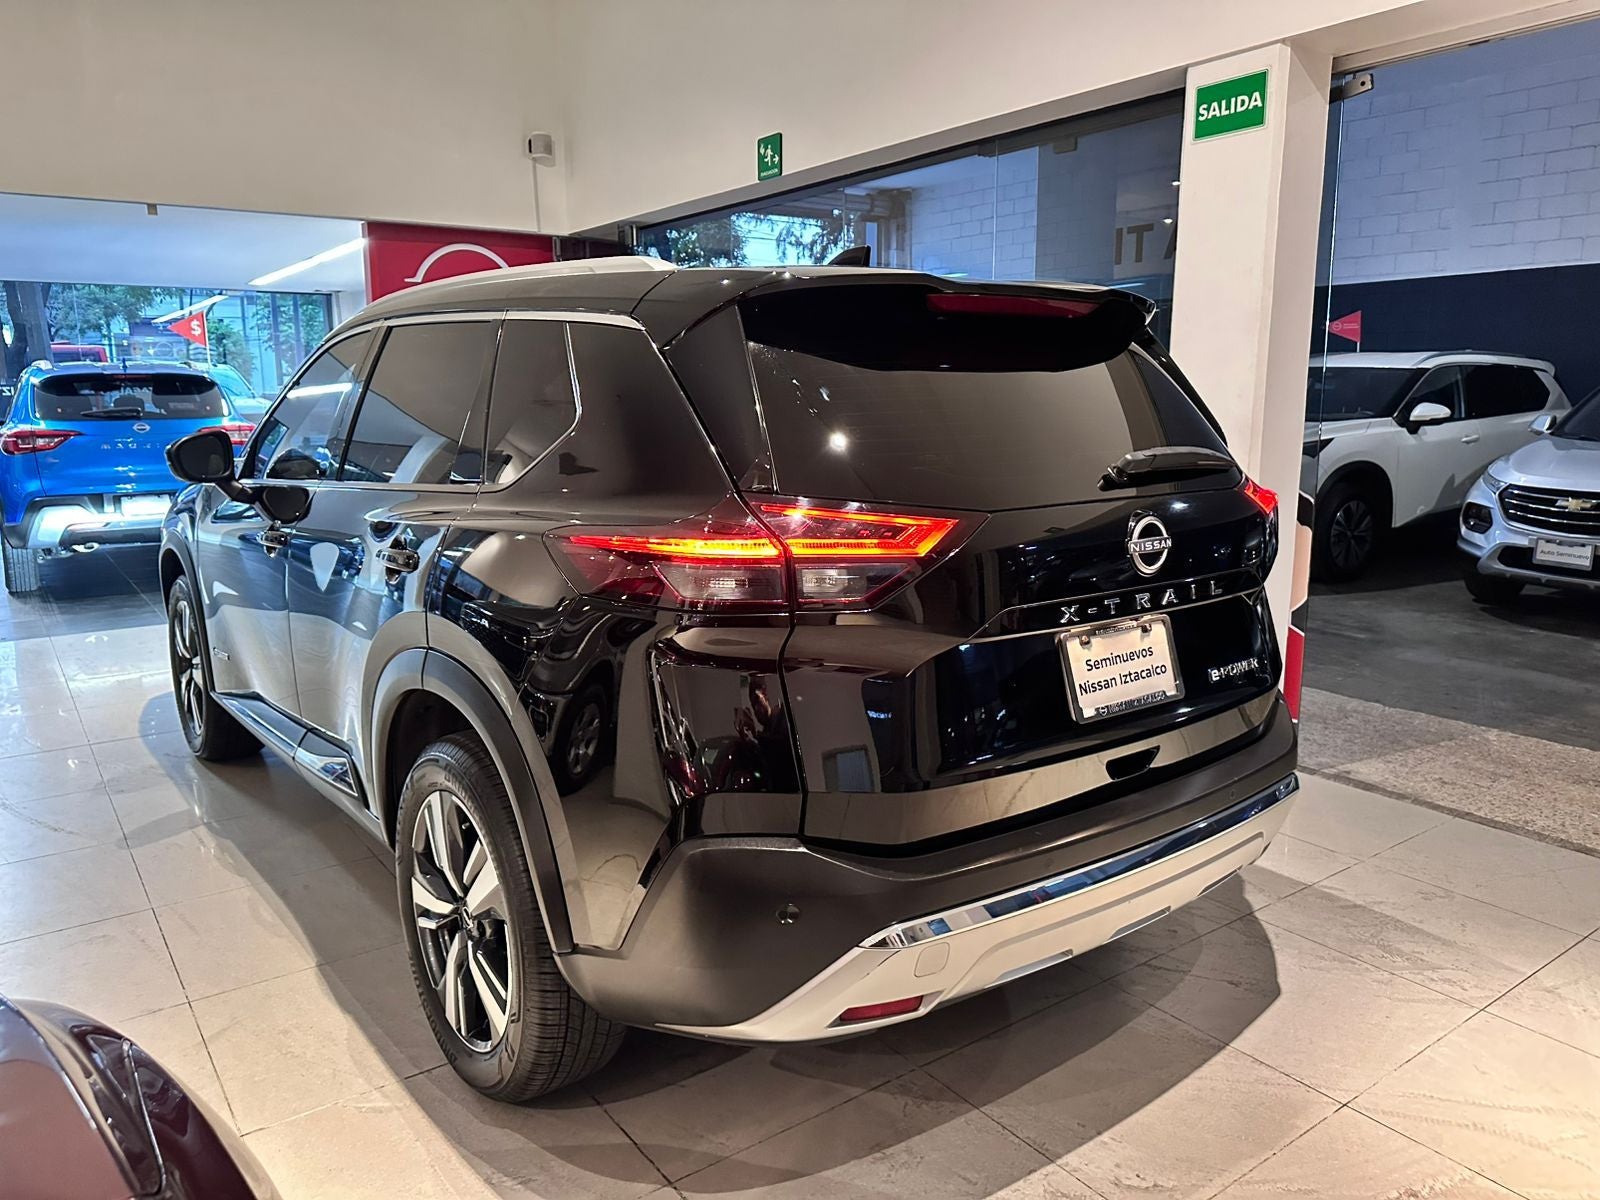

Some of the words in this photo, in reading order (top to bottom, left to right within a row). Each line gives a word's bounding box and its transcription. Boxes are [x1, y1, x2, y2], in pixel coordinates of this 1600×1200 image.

[1197, 91, 1263, 121] SALIDA
[1130, 538, 1172, 552] NISSAN
[1060, 580, 1223, 624] X-TRAIL
[1085, 646, 1154, 671] Seminuevos
[1078, 676, 1117, 696] Nissan
[1119, 664, 1167, 684] Iztacalco
